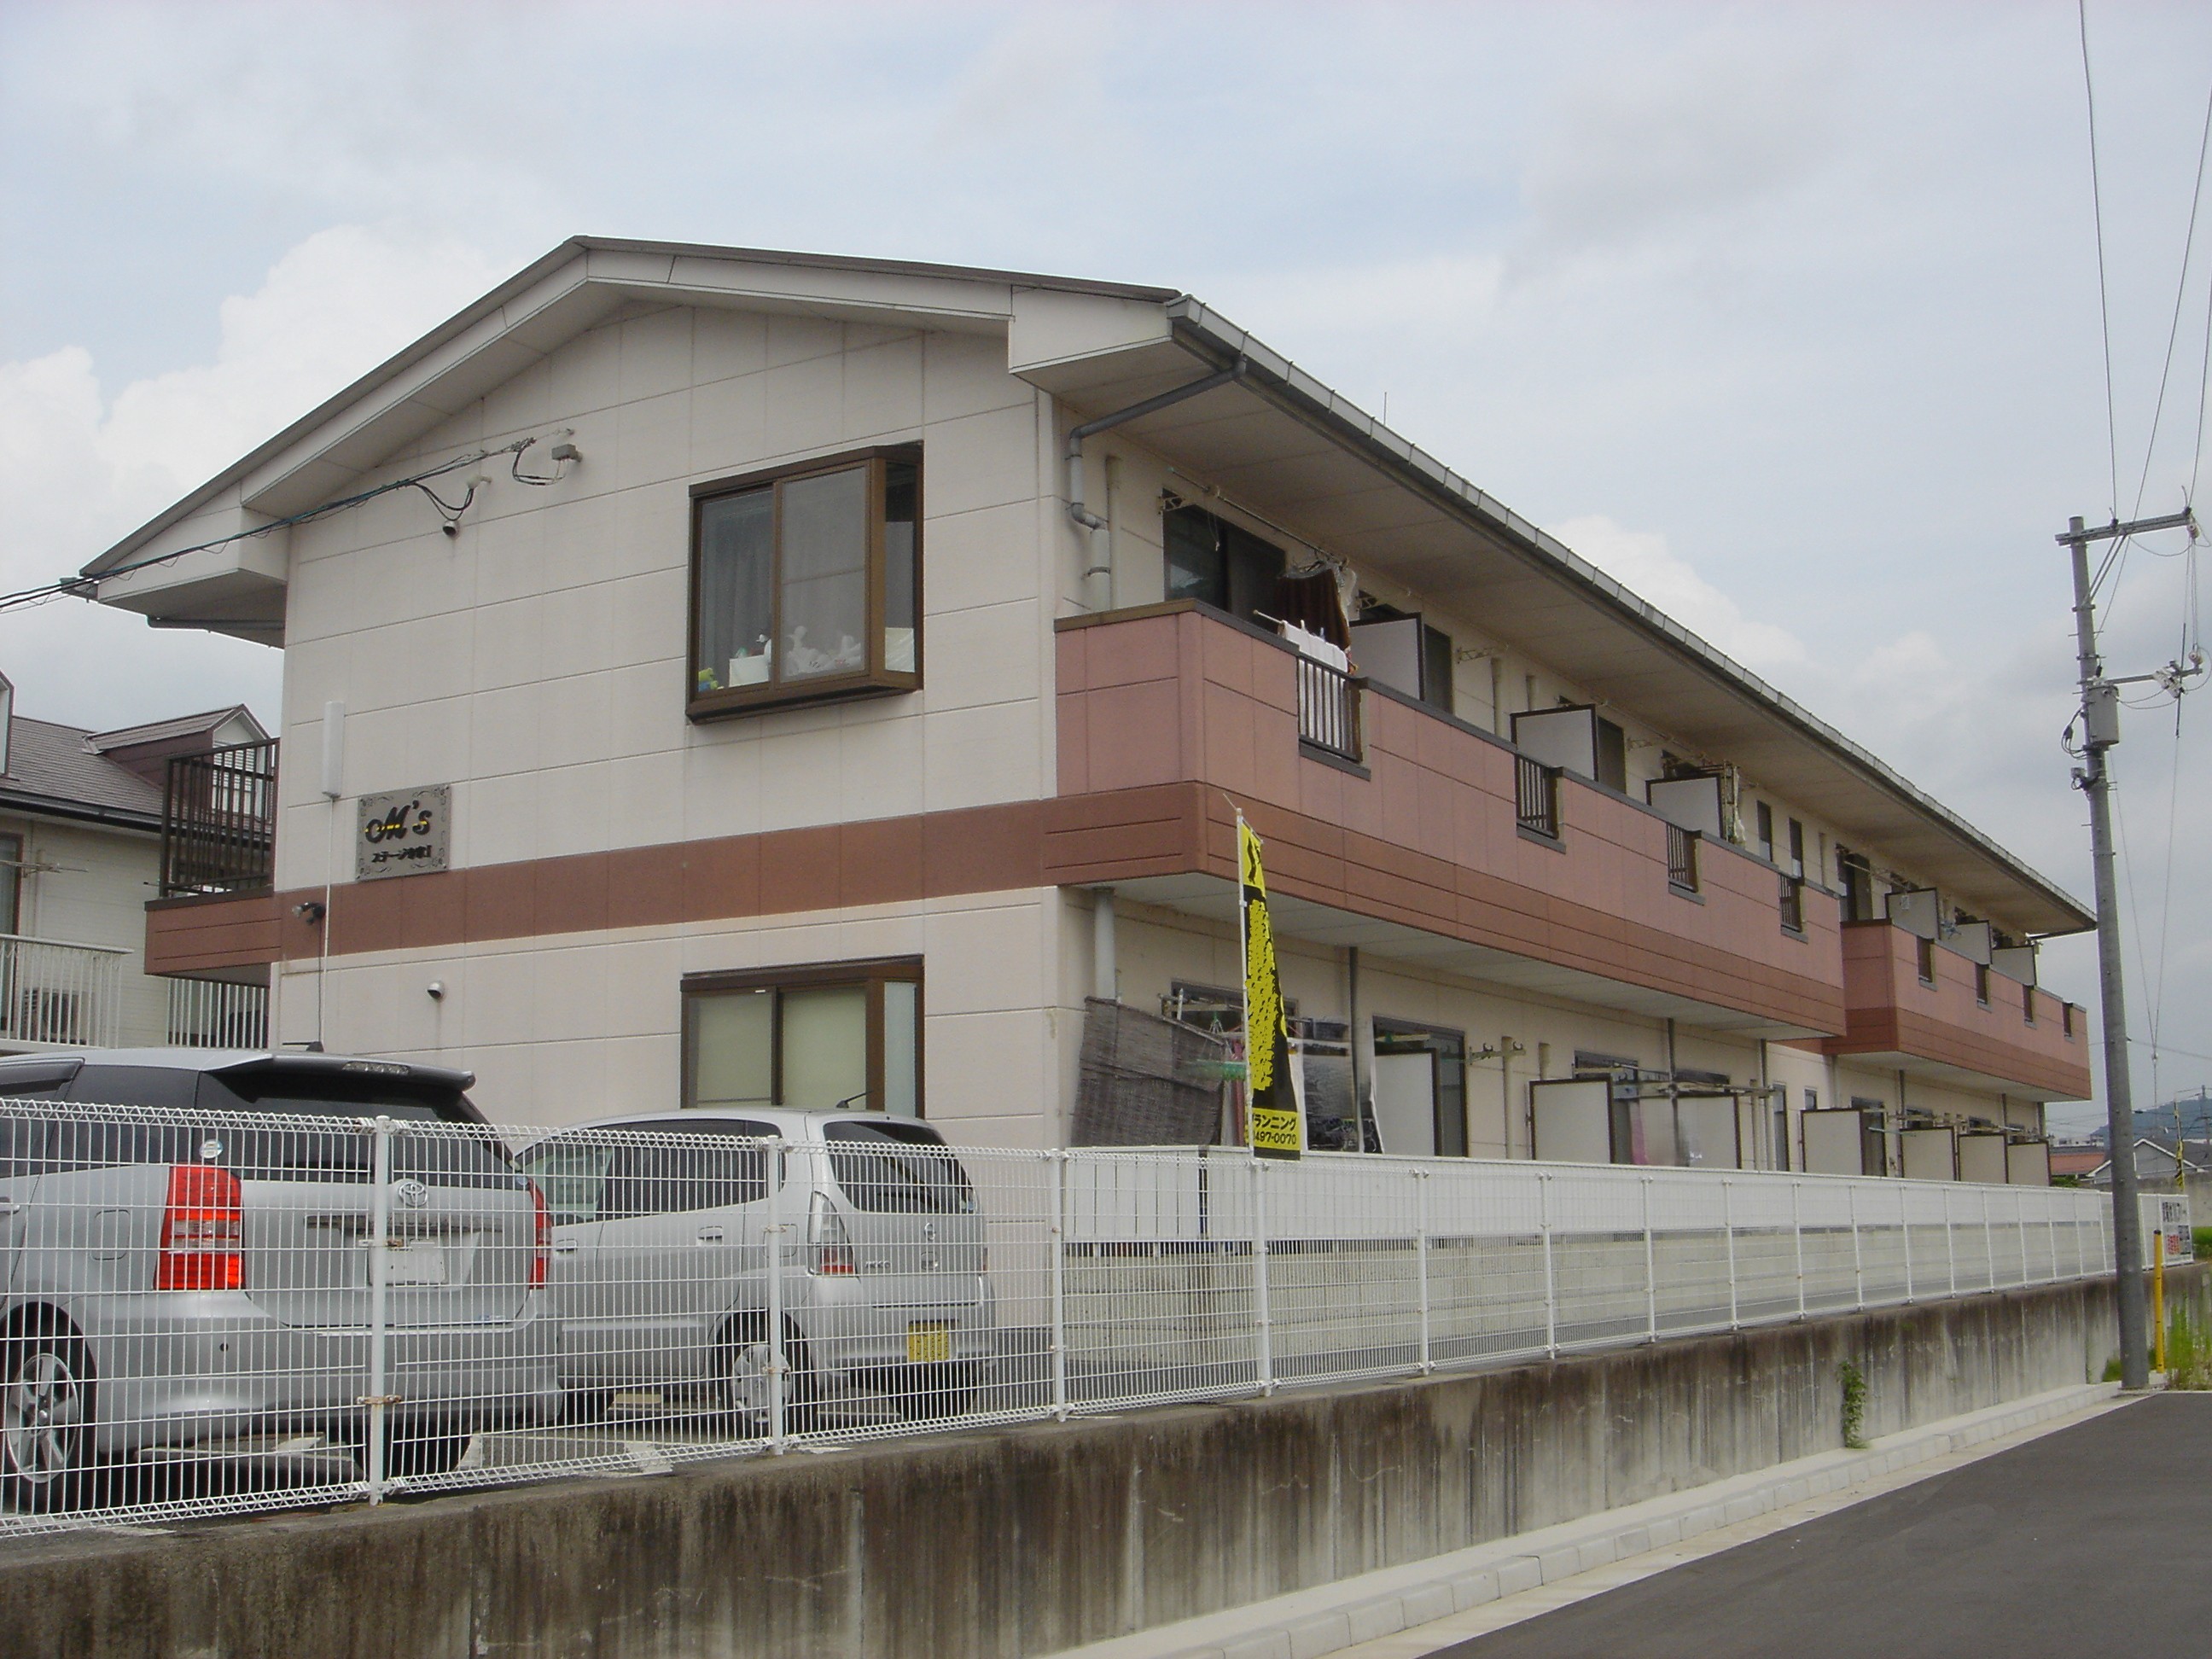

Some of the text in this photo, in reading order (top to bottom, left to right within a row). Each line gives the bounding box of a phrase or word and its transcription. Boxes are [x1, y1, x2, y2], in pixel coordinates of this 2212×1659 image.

[1253, 1113, 1296, 1131] ランニング
[1254, 1131, 1296, 1144] 497-0070
